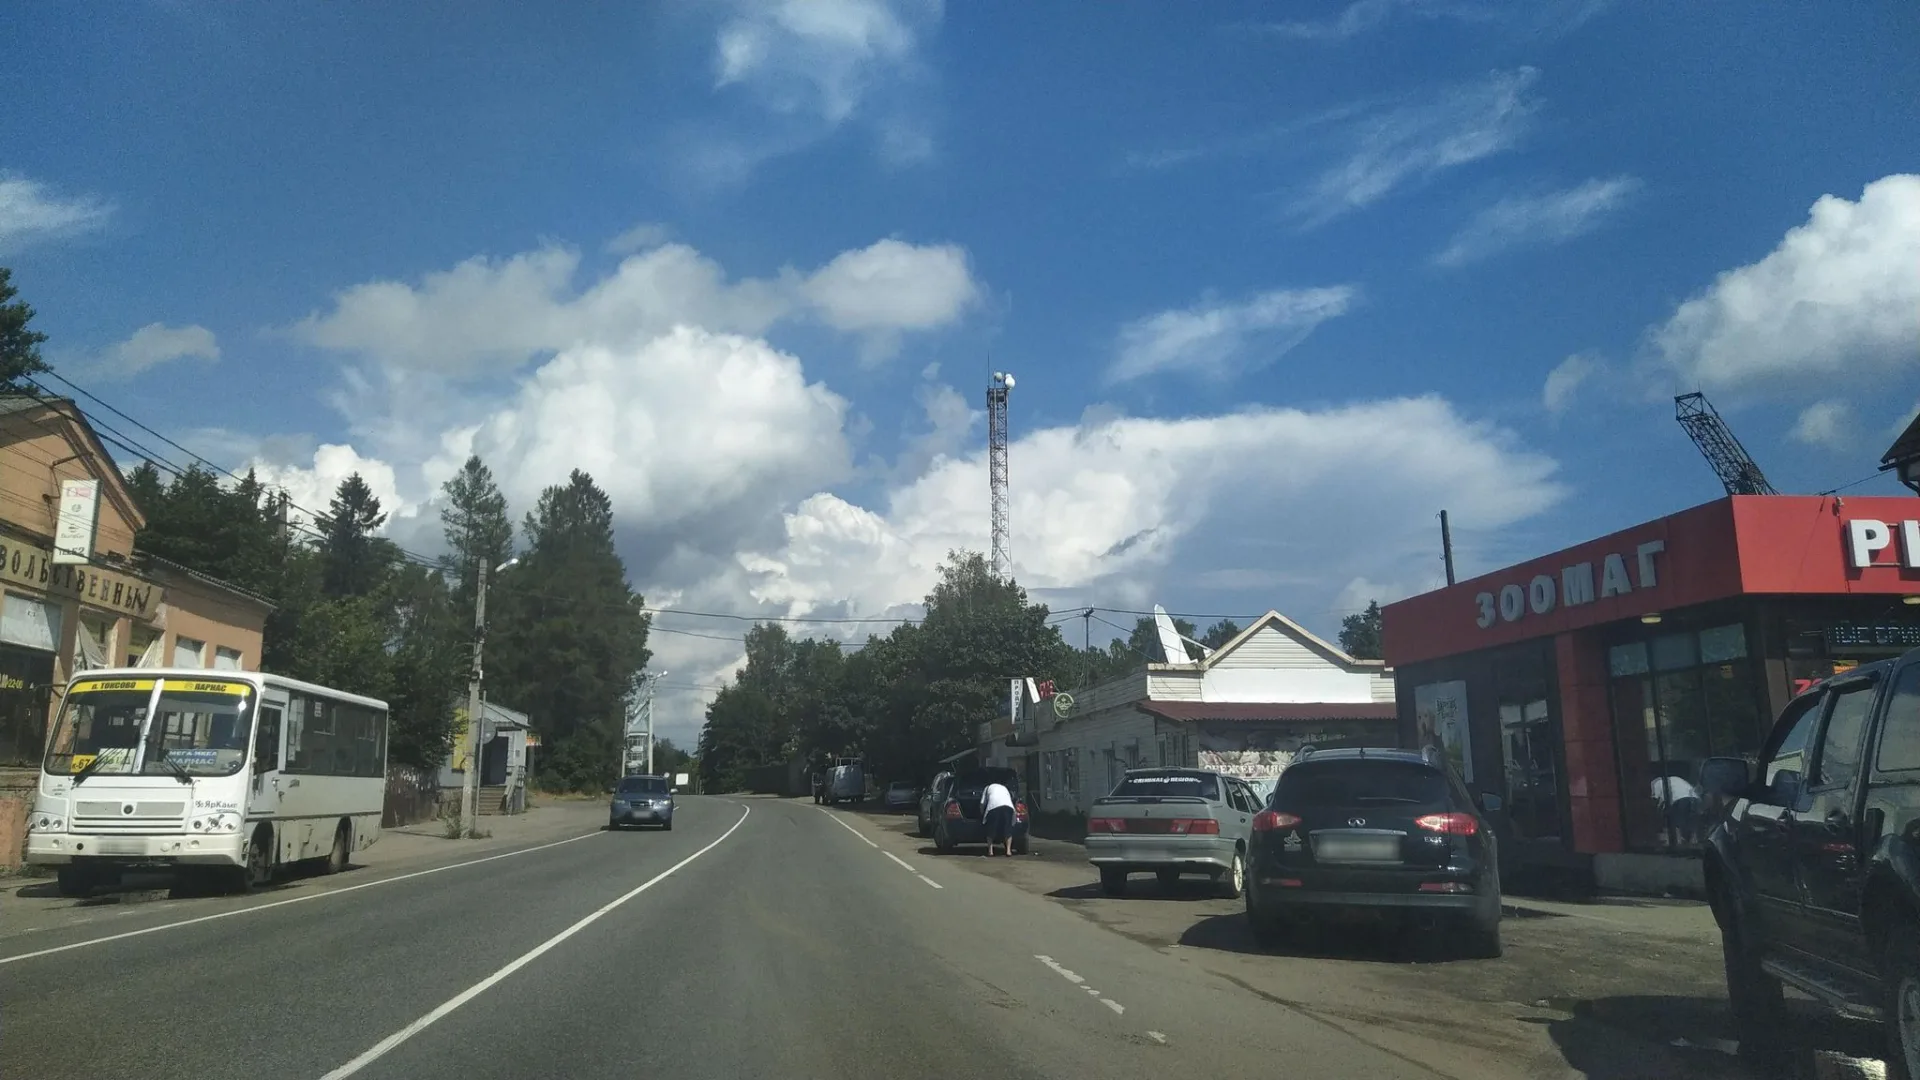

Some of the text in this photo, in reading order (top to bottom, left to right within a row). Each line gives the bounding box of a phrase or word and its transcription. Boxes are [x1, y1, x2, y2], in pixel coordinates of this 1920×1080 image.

[1474, 540, 1666, 630] ЗООМАГ
[100, 681, 136, 690] ТОКСОВО
[194, 683, 227, 692] ПАРНАС
